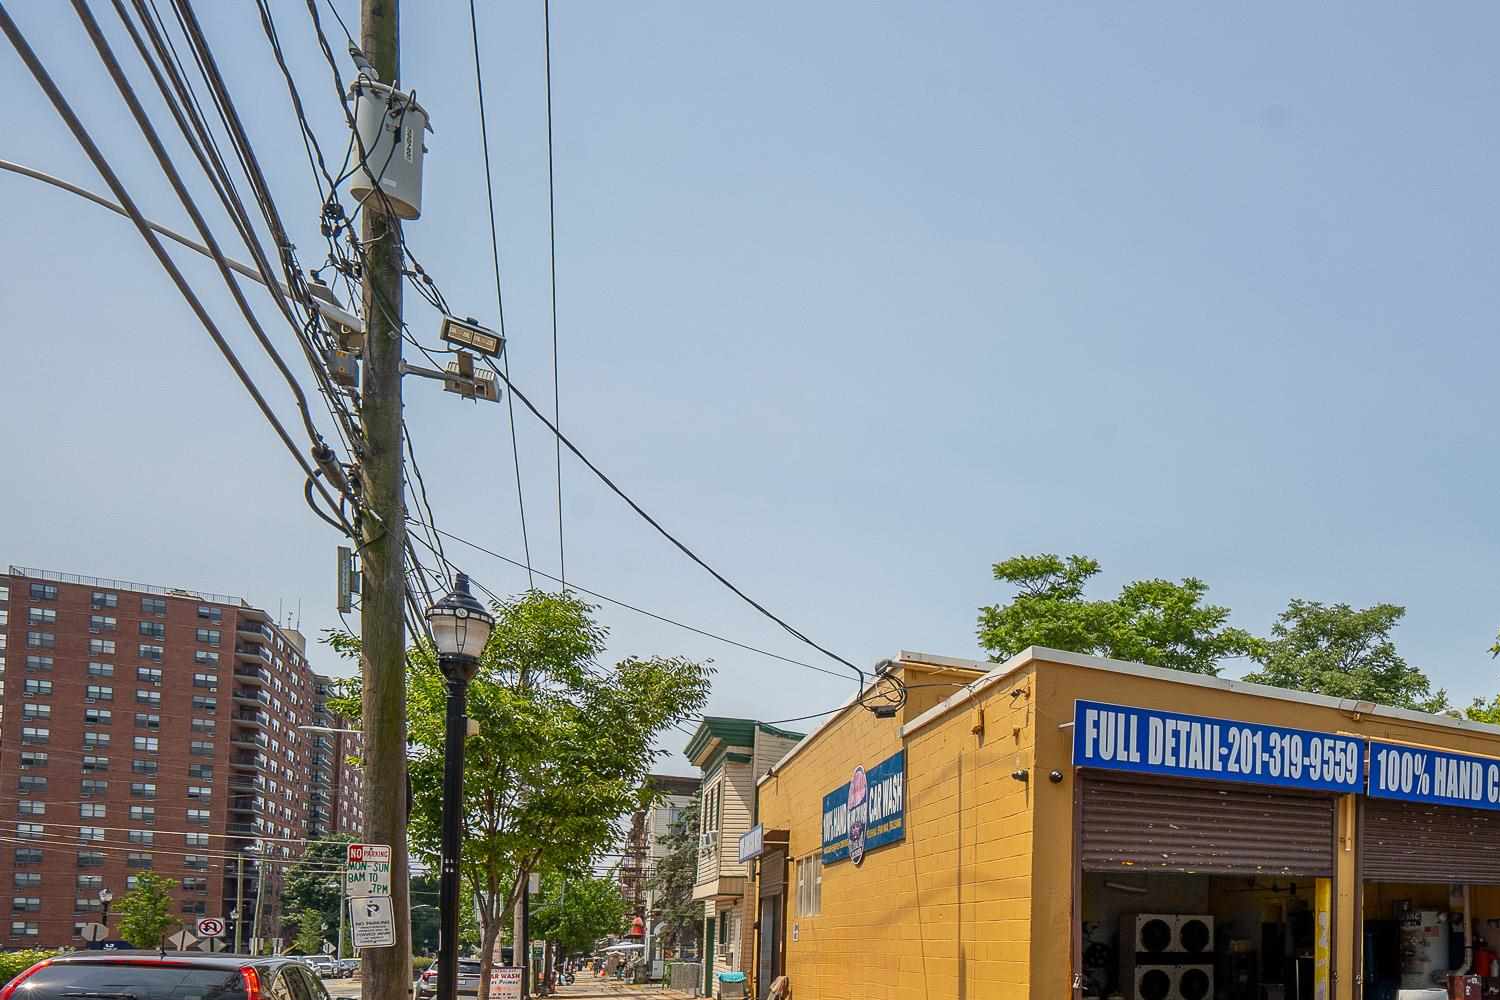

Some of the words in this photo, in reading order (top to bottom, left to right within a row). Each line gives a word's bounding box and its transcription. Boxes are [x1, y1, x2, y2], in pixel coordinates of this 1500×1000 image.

[1085, 709, 1140, 762] FULL
[1377, 749, 1430, 795] 100%
[1434, 757, 1483, 800] HAND
[869, 783, 882, 823] CAR
[882, 772, 903, 818] WASH
[350, 849, 362, 859] NO
[364, 850, 389, 858] PARKING
[347, 873, 366, 883] 8AM
[369, 872, 379, 882] TO
[372, 883, 389, 894] 7PM
